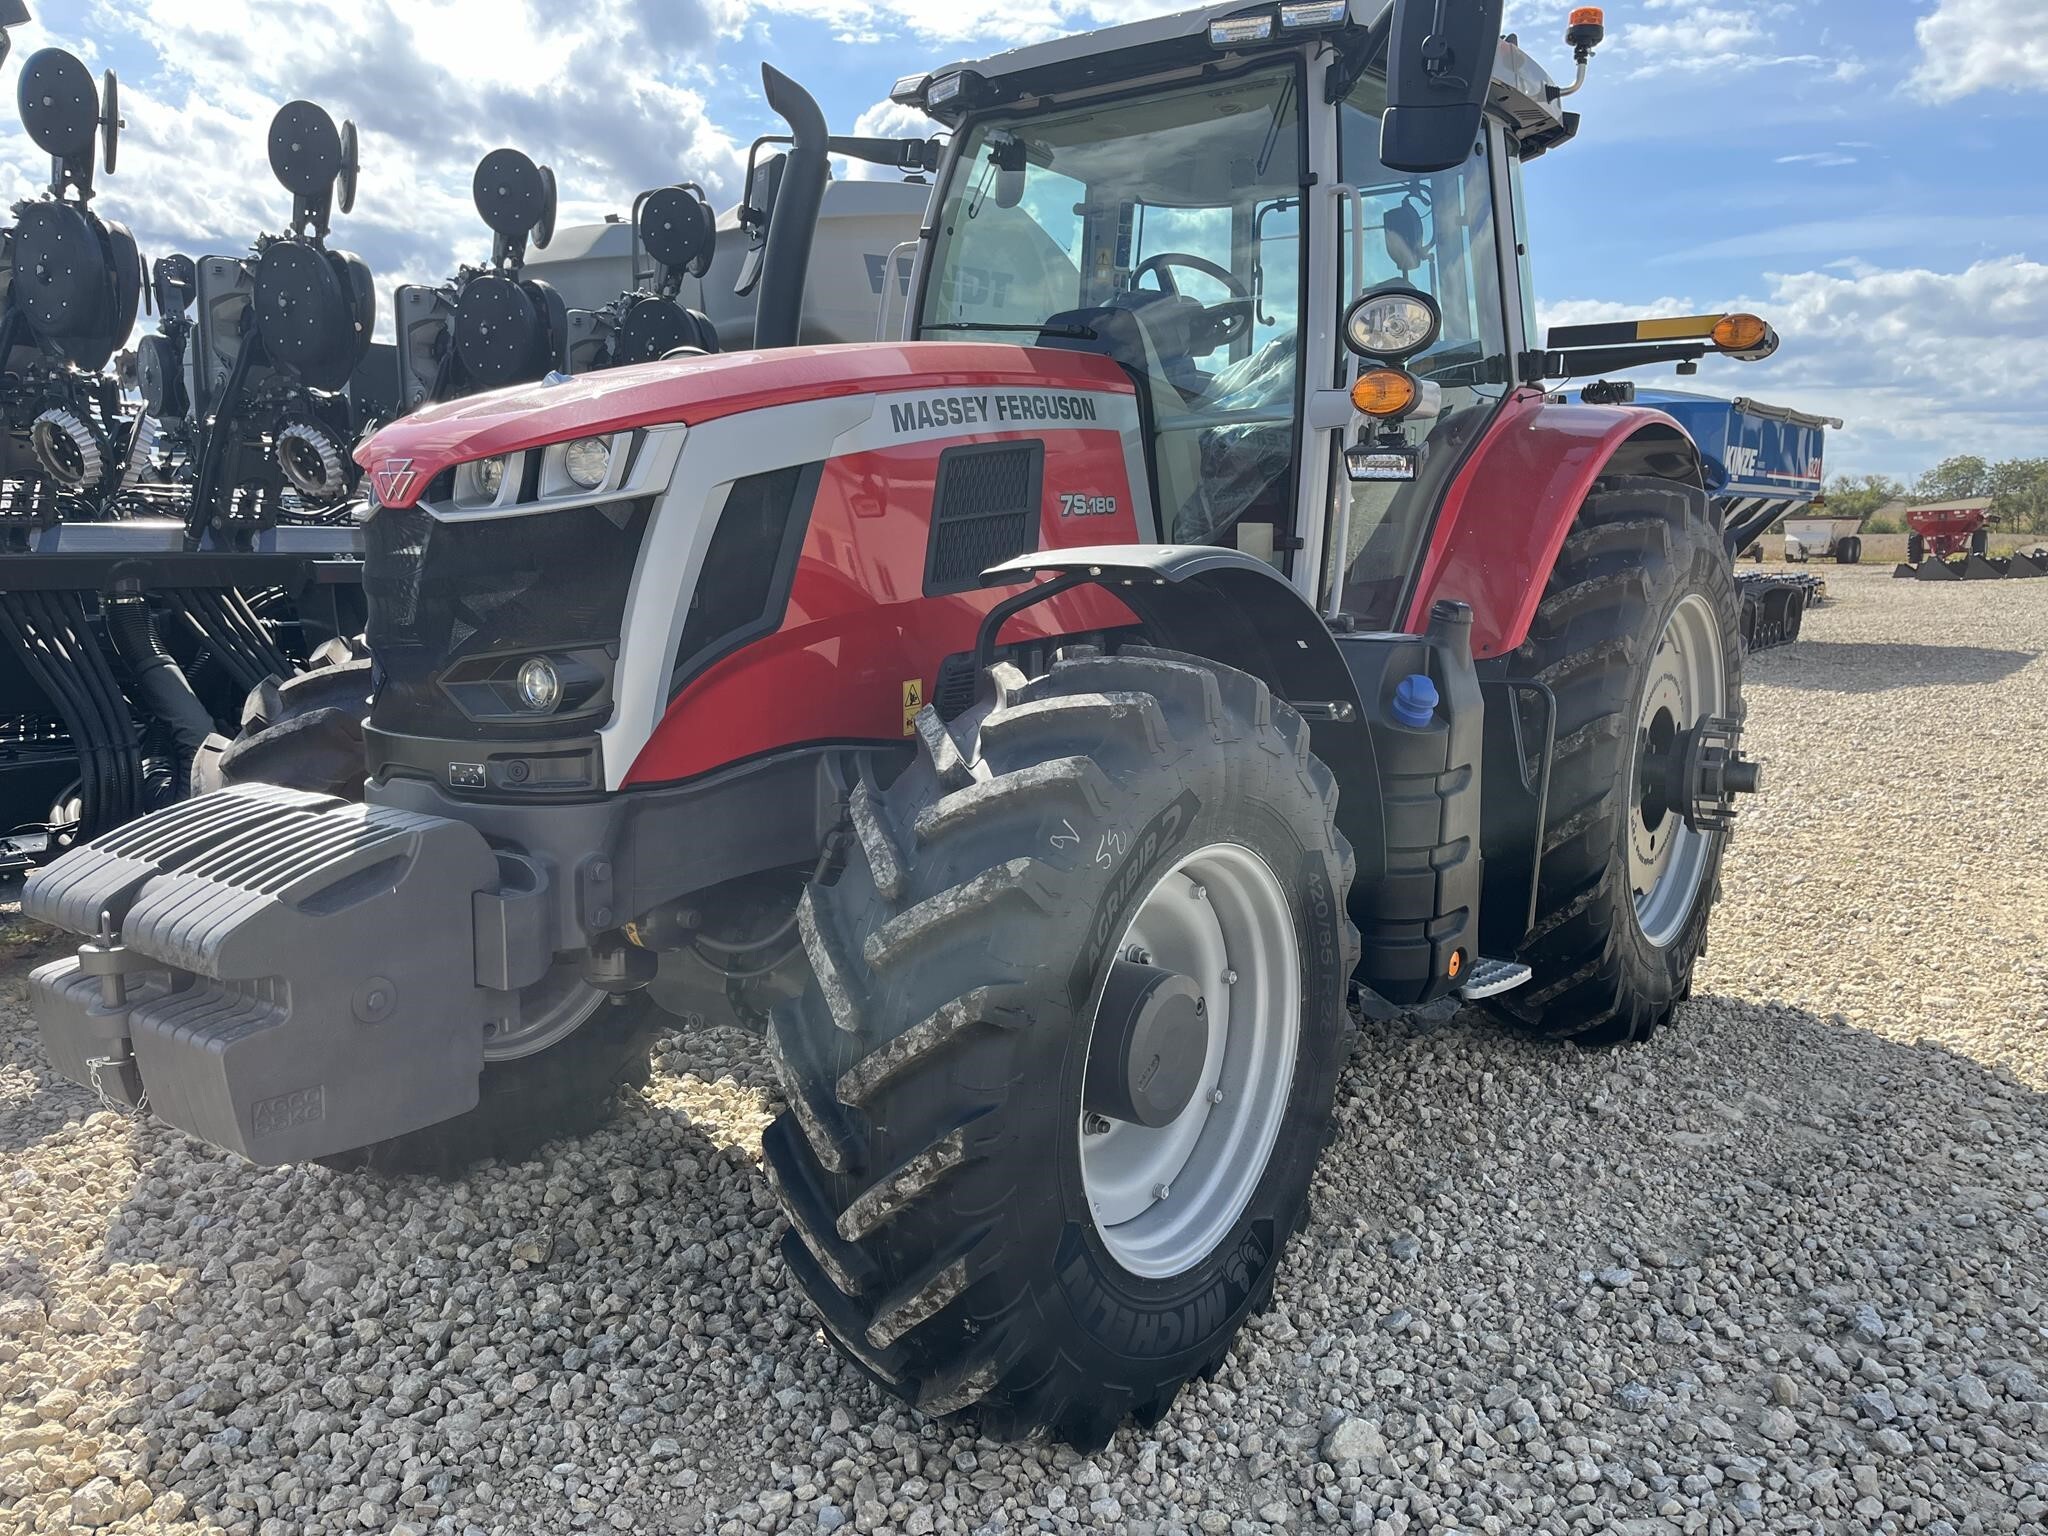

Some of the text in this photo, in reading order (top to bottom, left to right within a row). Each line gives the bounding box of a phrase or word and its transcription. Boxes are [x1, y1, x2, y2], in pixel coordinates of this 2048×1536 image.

[890, 395, 1097, 433] MASSEY FERGUSON
[1725, 446, 1758, 477] KINZE
[1060, 494, 1117, 517] 7S.180
[1060, 1254, 1227, 1350] MICHELIN
